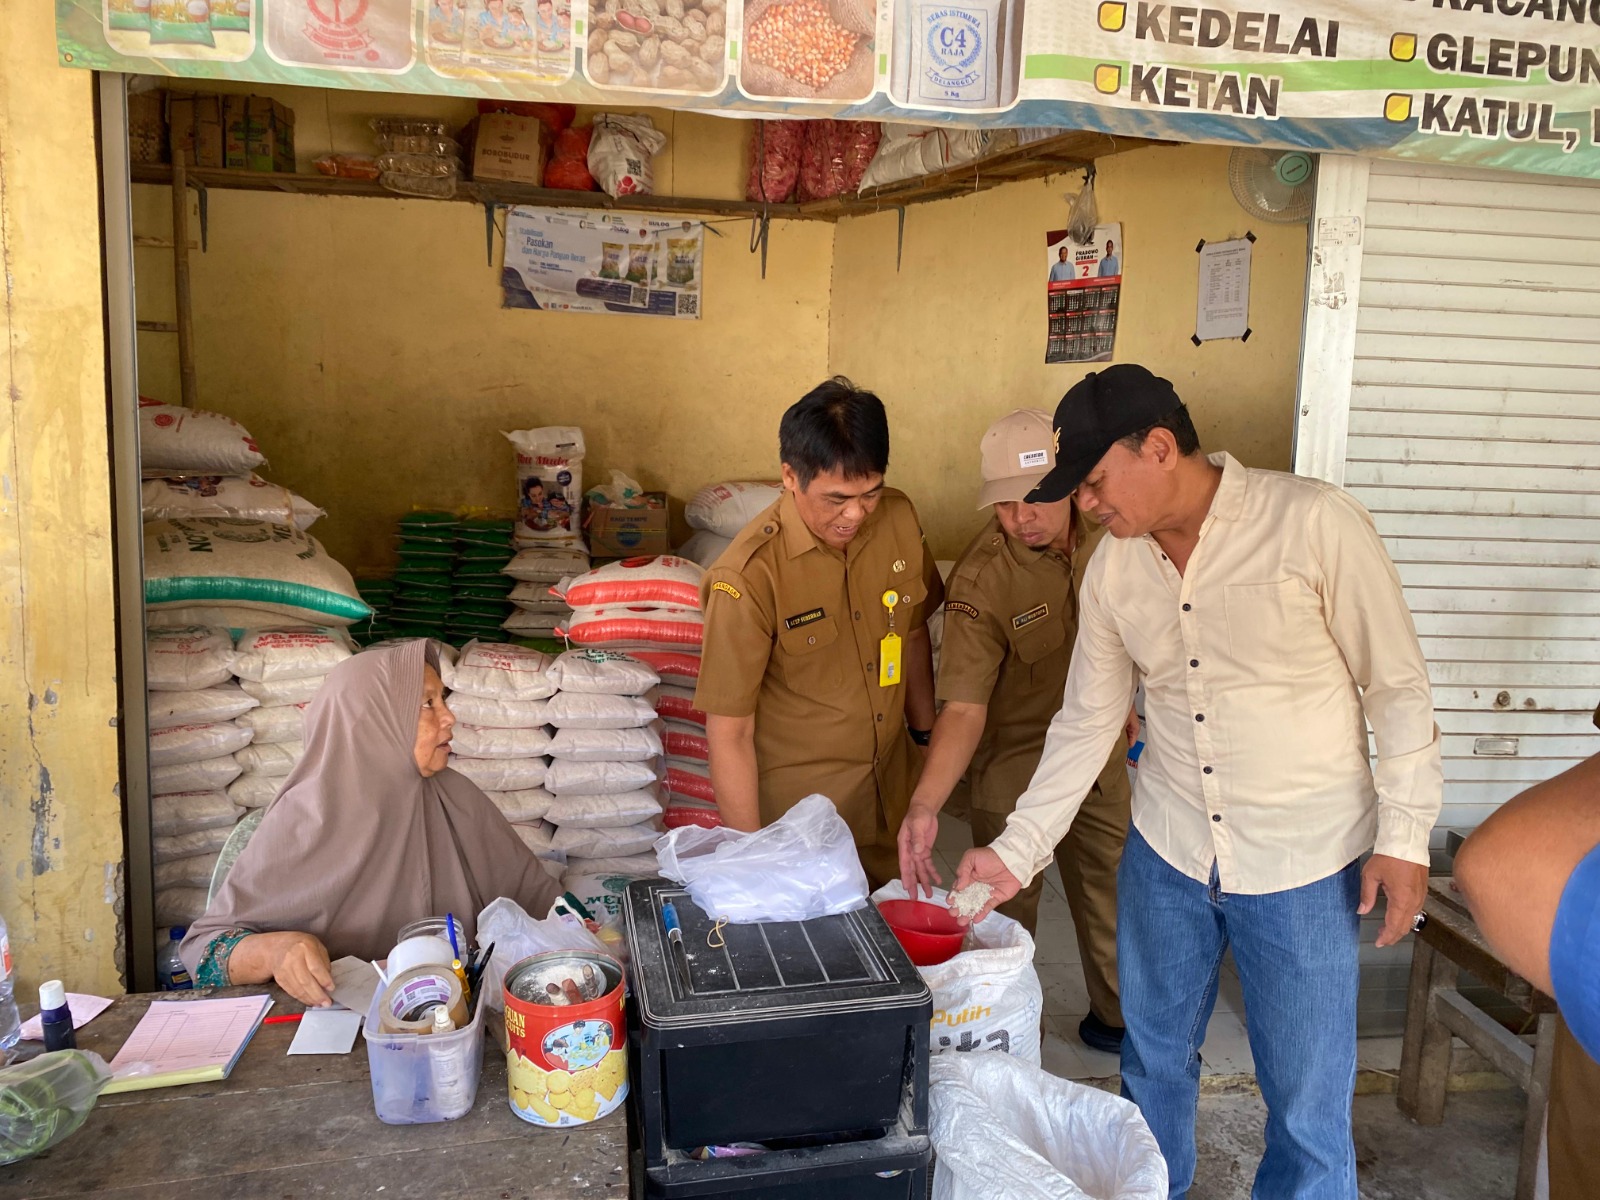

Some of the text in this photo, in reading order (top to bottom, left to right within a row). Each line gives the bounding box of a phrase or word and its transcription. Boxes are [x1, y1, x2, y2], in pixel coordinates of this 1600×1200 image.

[927, 9, 981, 29] BERAS ISTIMEWA
[940, 26, 967, 48] C4
[1135, 1, 1340, 58] KEDELAI
[941, 48, 965, 56] RAJA
[1130, 64, 1280, 117] KETAN
[1421, 92, 1577, 150] KATUL,
[481, 149, 531, 161] BOROBUDUR
[526, 236, 554, 249] Pasokan
[1081, 265, 1090, 277] 2
[257, 633, 285, 643] APEL
[930, 1004, 991, 1030] Putih
